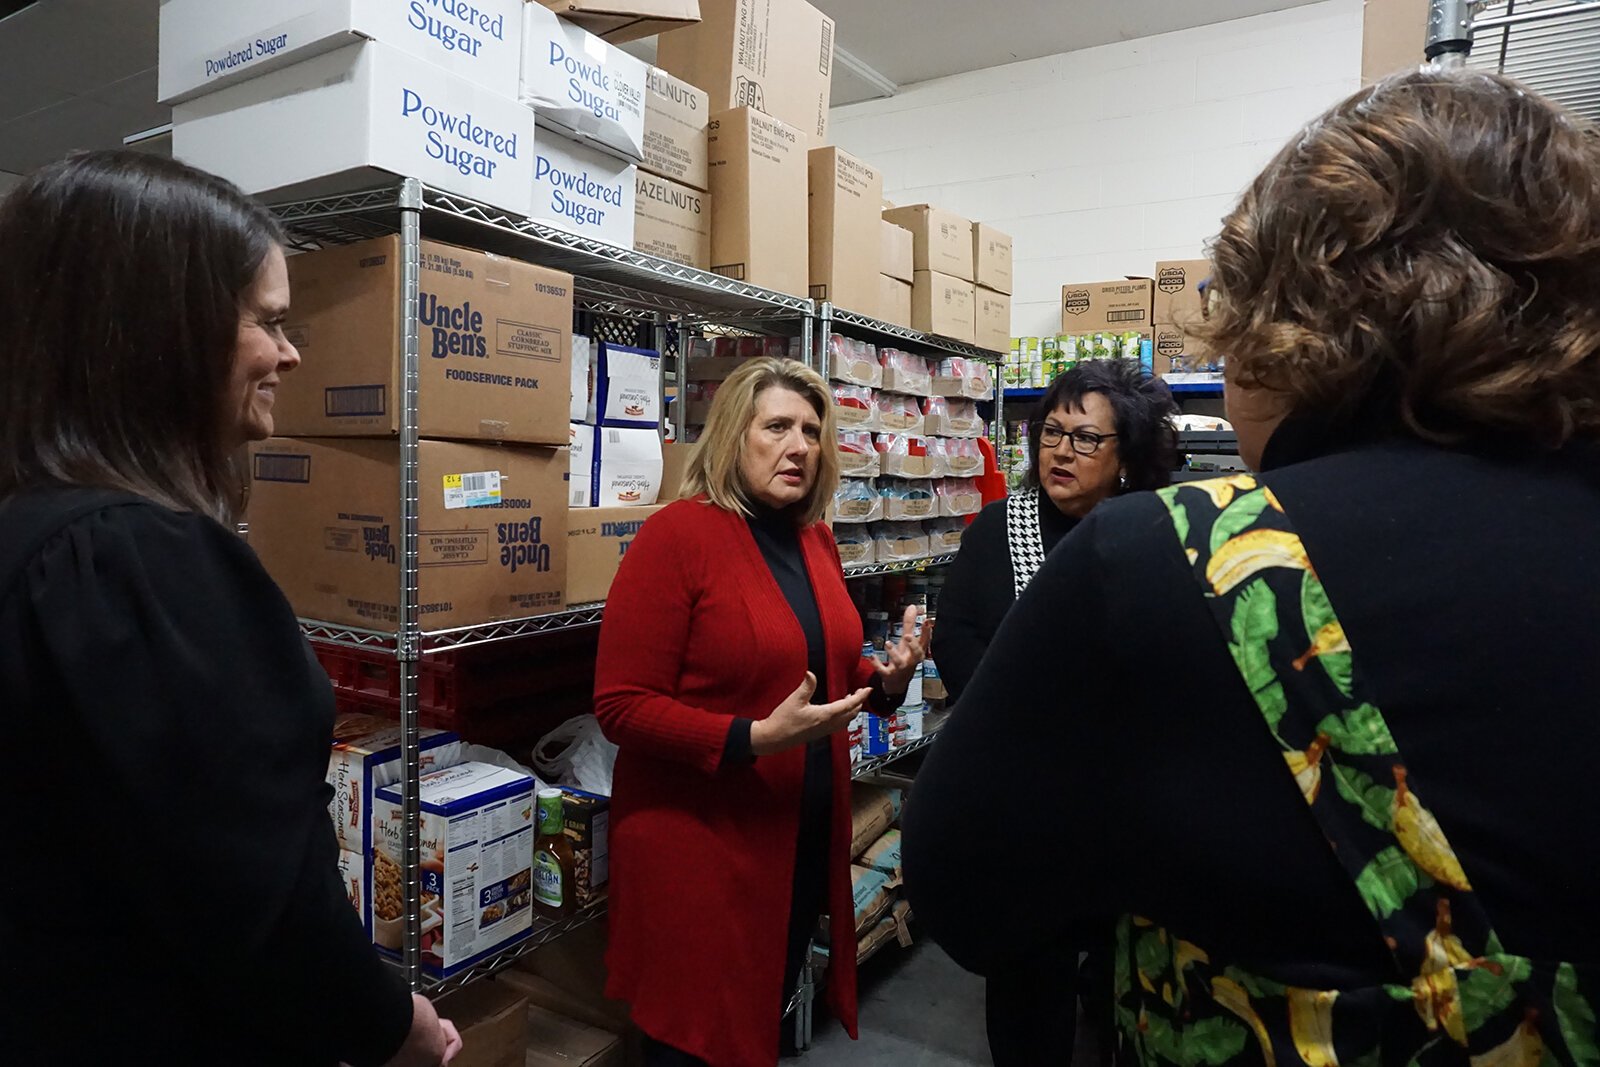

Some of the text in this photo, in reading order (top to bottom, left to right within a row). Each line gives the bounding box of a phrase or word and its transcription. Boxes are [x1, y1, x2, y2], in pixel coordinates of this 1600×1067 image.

[408, 1, 483, 57] Sugar
[427, 0, 504, 41] dered
[205, 33, 288, 77] Powdered Sugar
[738, 27, 747, 65] WALNUT
[549, 41, 609, 92] Powde
[646, 73, 697, 111] ZELNUTS
[402, 87, 519, 160] Powdered
[709, 120, 720, 130] CS
[751, 116, 773, 132] WALNUT
[773, 126, 785, 138] ENG
[785, 131, 796, 143] PCS
[426, 130, 498, 181] Sugar
[536, 156, 622, 207] Powdered
[551, 190, 606, 226] Sugar
[419, 292, 483, 333] Uncle
[432, 327, 487, 359] Ben's
[508, 342, 553, 355] STUFFING MIX
[511, 335, 550, 347] CORNBREAD
[516, 328, 543, 339] CLASSIC
[446, 369, 539, 389] FOODSERVICE PACK
[363, 524, 390, 544] Ben's
[497, 516, 542, 544] Ben's
[365, 541, 396, 564] Uncle
[500, 543, 551, 573] Uncle
[337, 761, 349, 841] Herb Seasoned
[379, 819, 400, 840] Herb
[426, 884, 440, 893] PACK
[429, 872, 437, 887] 3
[484, 889, 492, 904] 3
